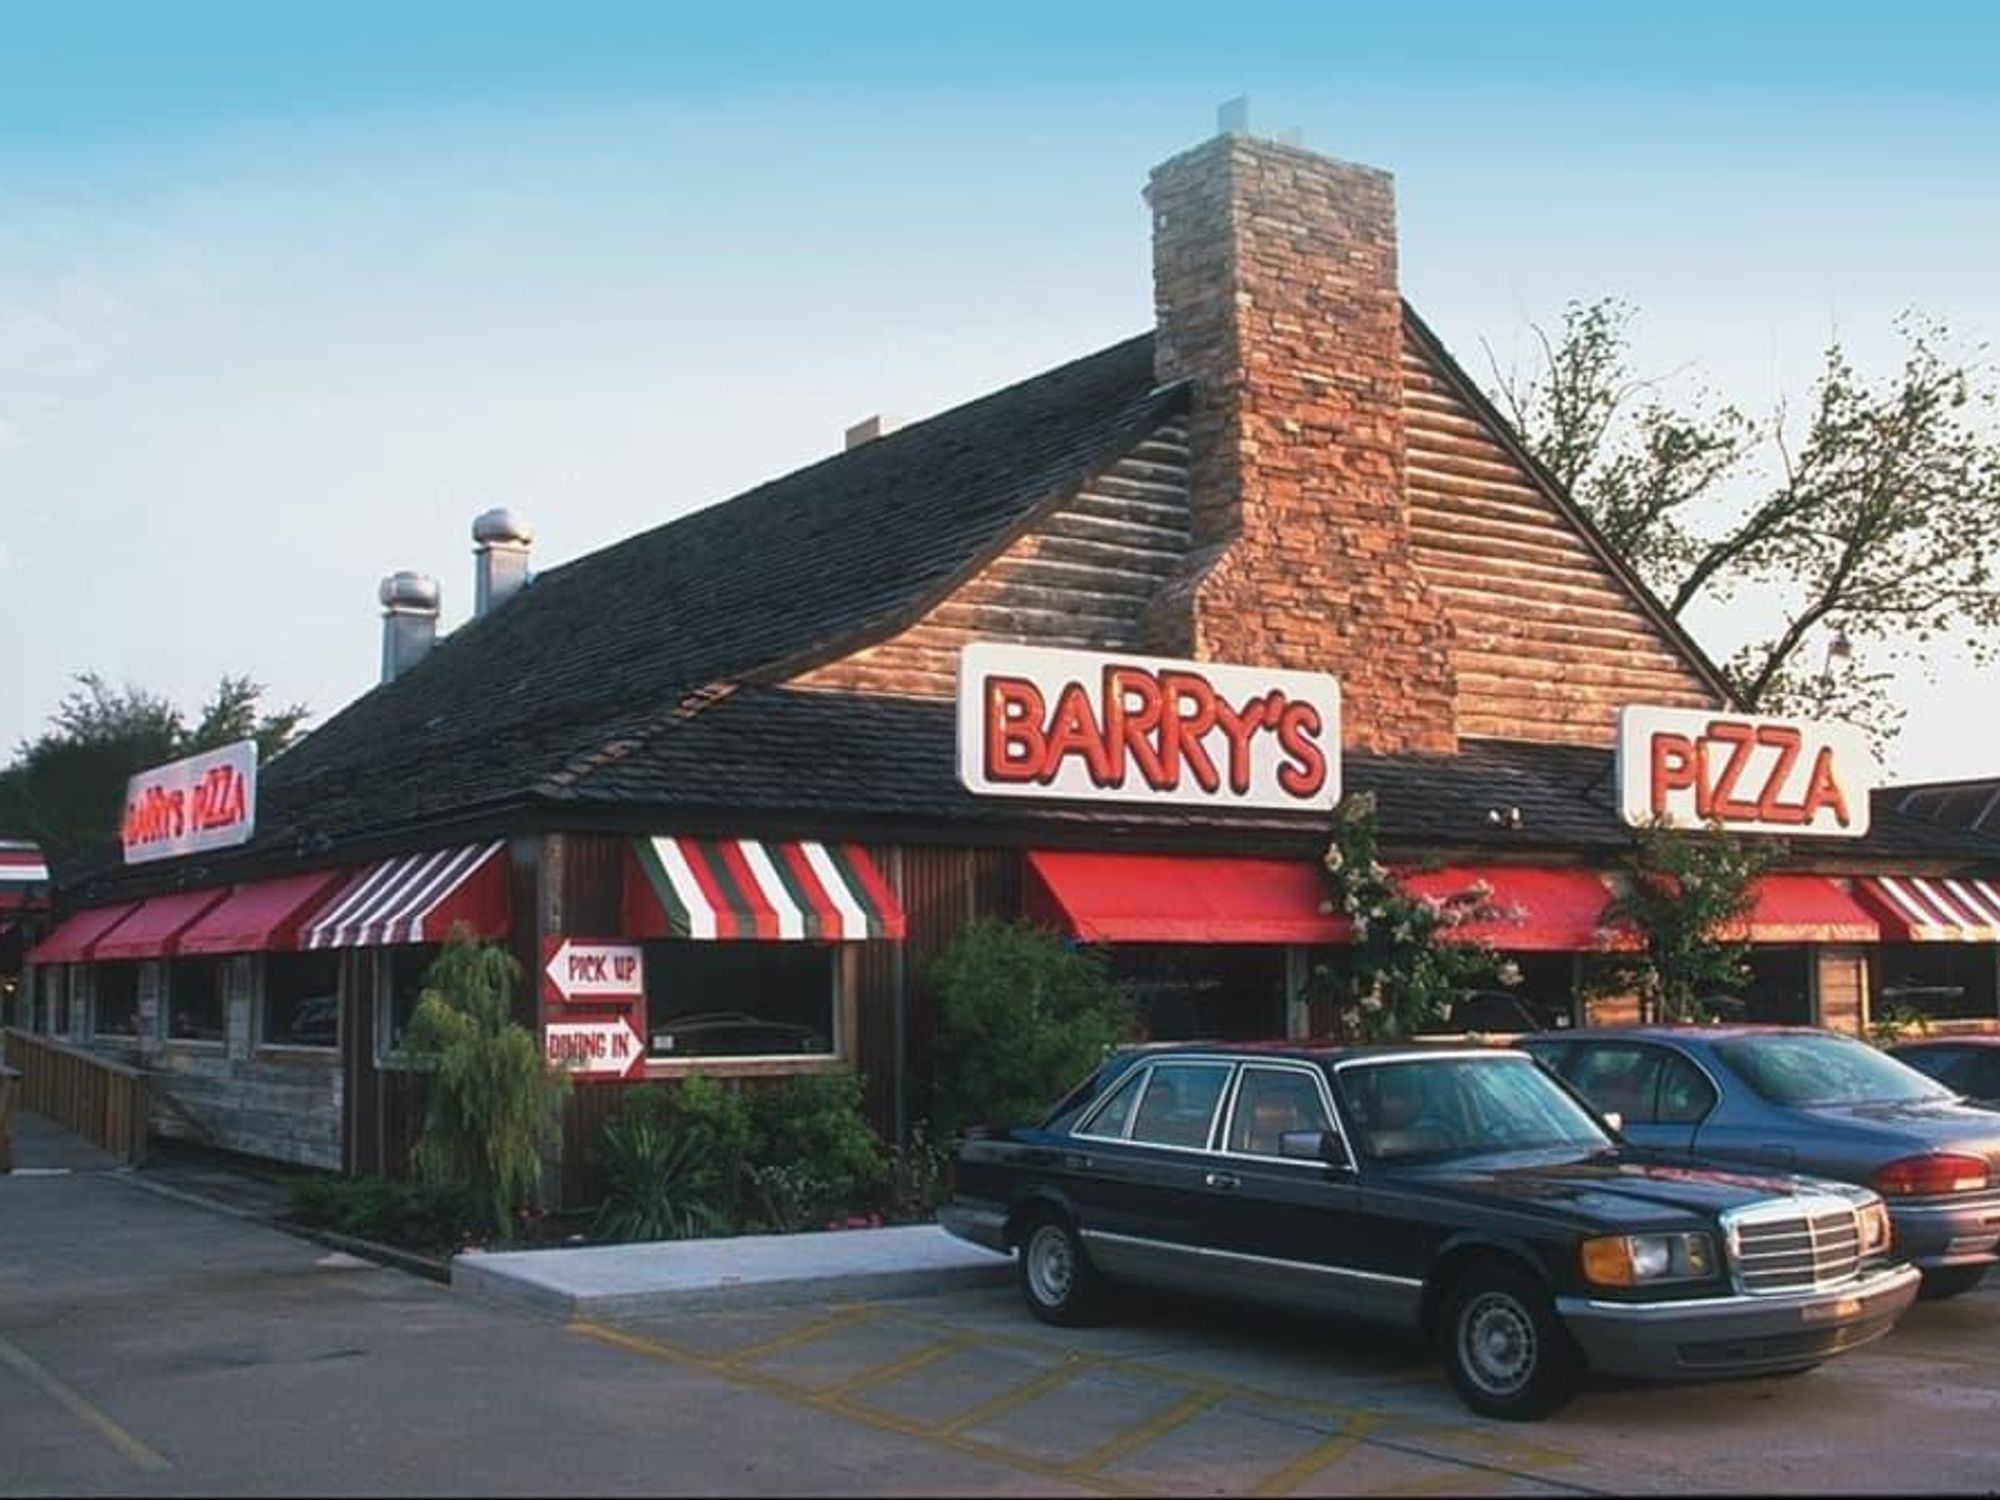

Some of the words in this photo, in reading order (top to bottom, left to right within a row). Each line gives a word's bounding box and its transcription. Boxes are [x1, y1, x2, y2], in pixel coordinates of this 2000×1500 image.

[984, 663, 1327, 799] BARRY'S
[192, 764, 246, 831] PIZZA
[1650, 720, 1850, 828] PIZZA
[568, 954, 608, 982] PICK
[613, 954, 636, 982] UP
[549, 1032, 606, 1061] DINING
[611, 1031, 630, 1058] IN
